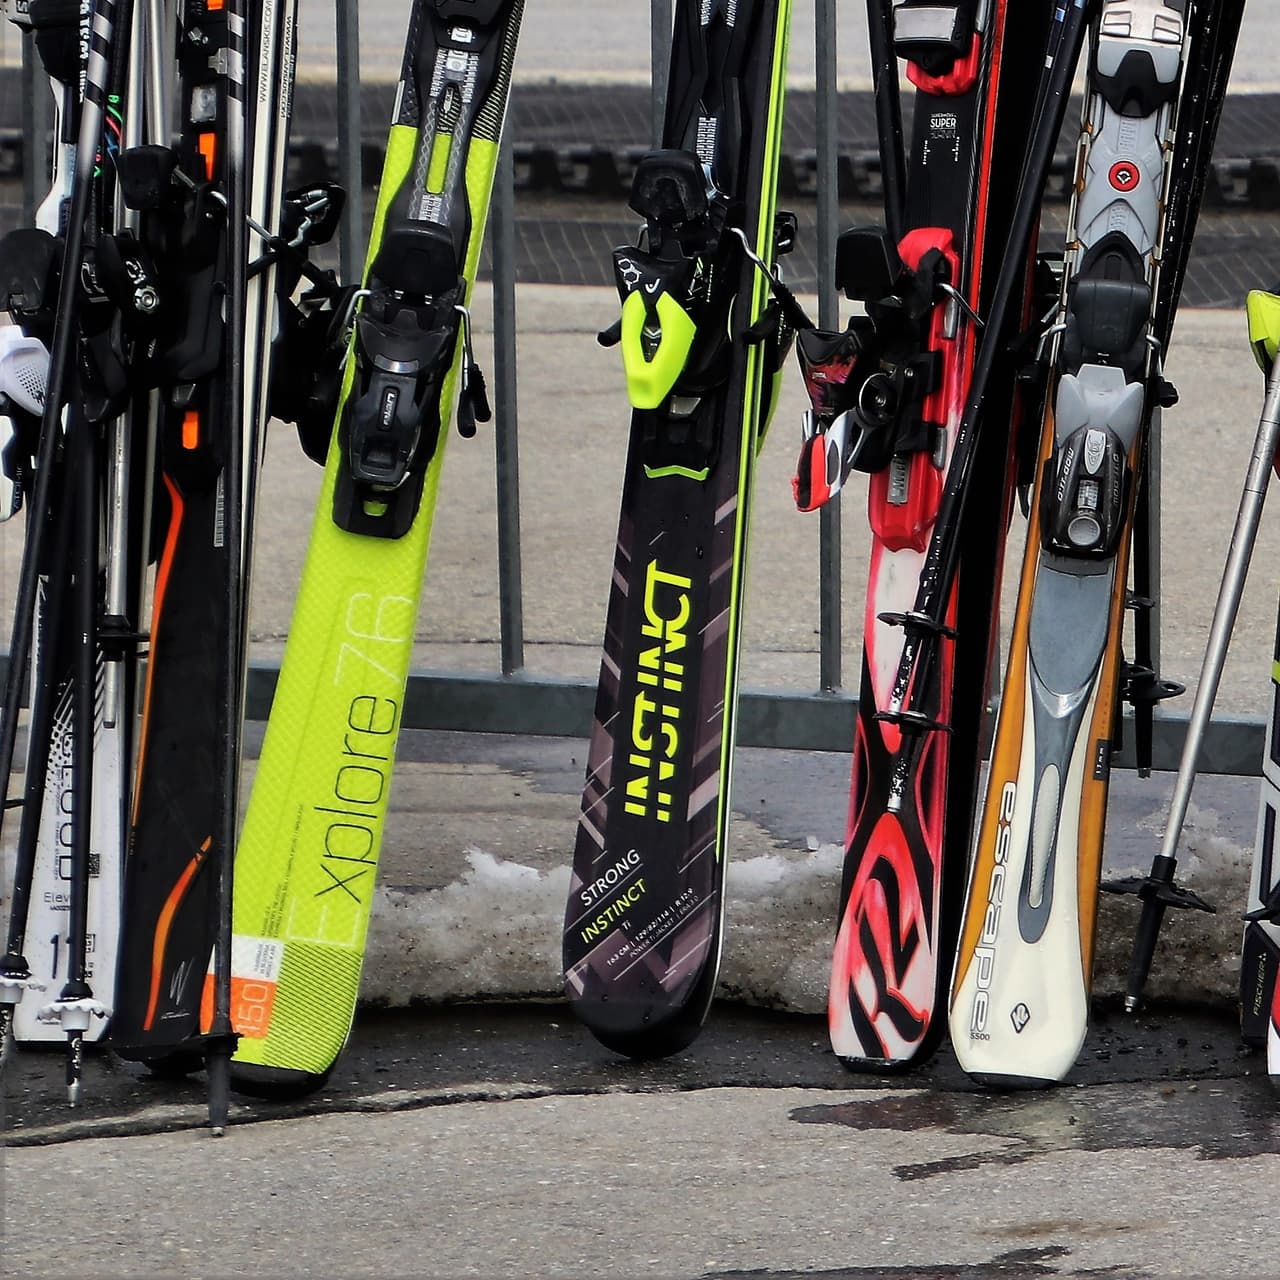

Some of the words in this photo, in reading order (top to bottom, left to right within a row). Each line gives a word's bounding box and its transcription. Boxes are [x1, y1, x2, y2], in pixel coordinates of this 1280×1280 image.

[930, 118, 957, 128] SUPER
[332, 590, 414, 689] 76
[624, 558, 693, 822] INSTINCT
[285, 694, 402, 950] Explore
[578, 848, 642, 909] STRONG
[580, 878, 648, 945] INSTINCT
[968, 780, 1016, 1032] escape
[235, 983, 269, 1034] 150
[1251, 961, 1267, 1017] FISCHER
